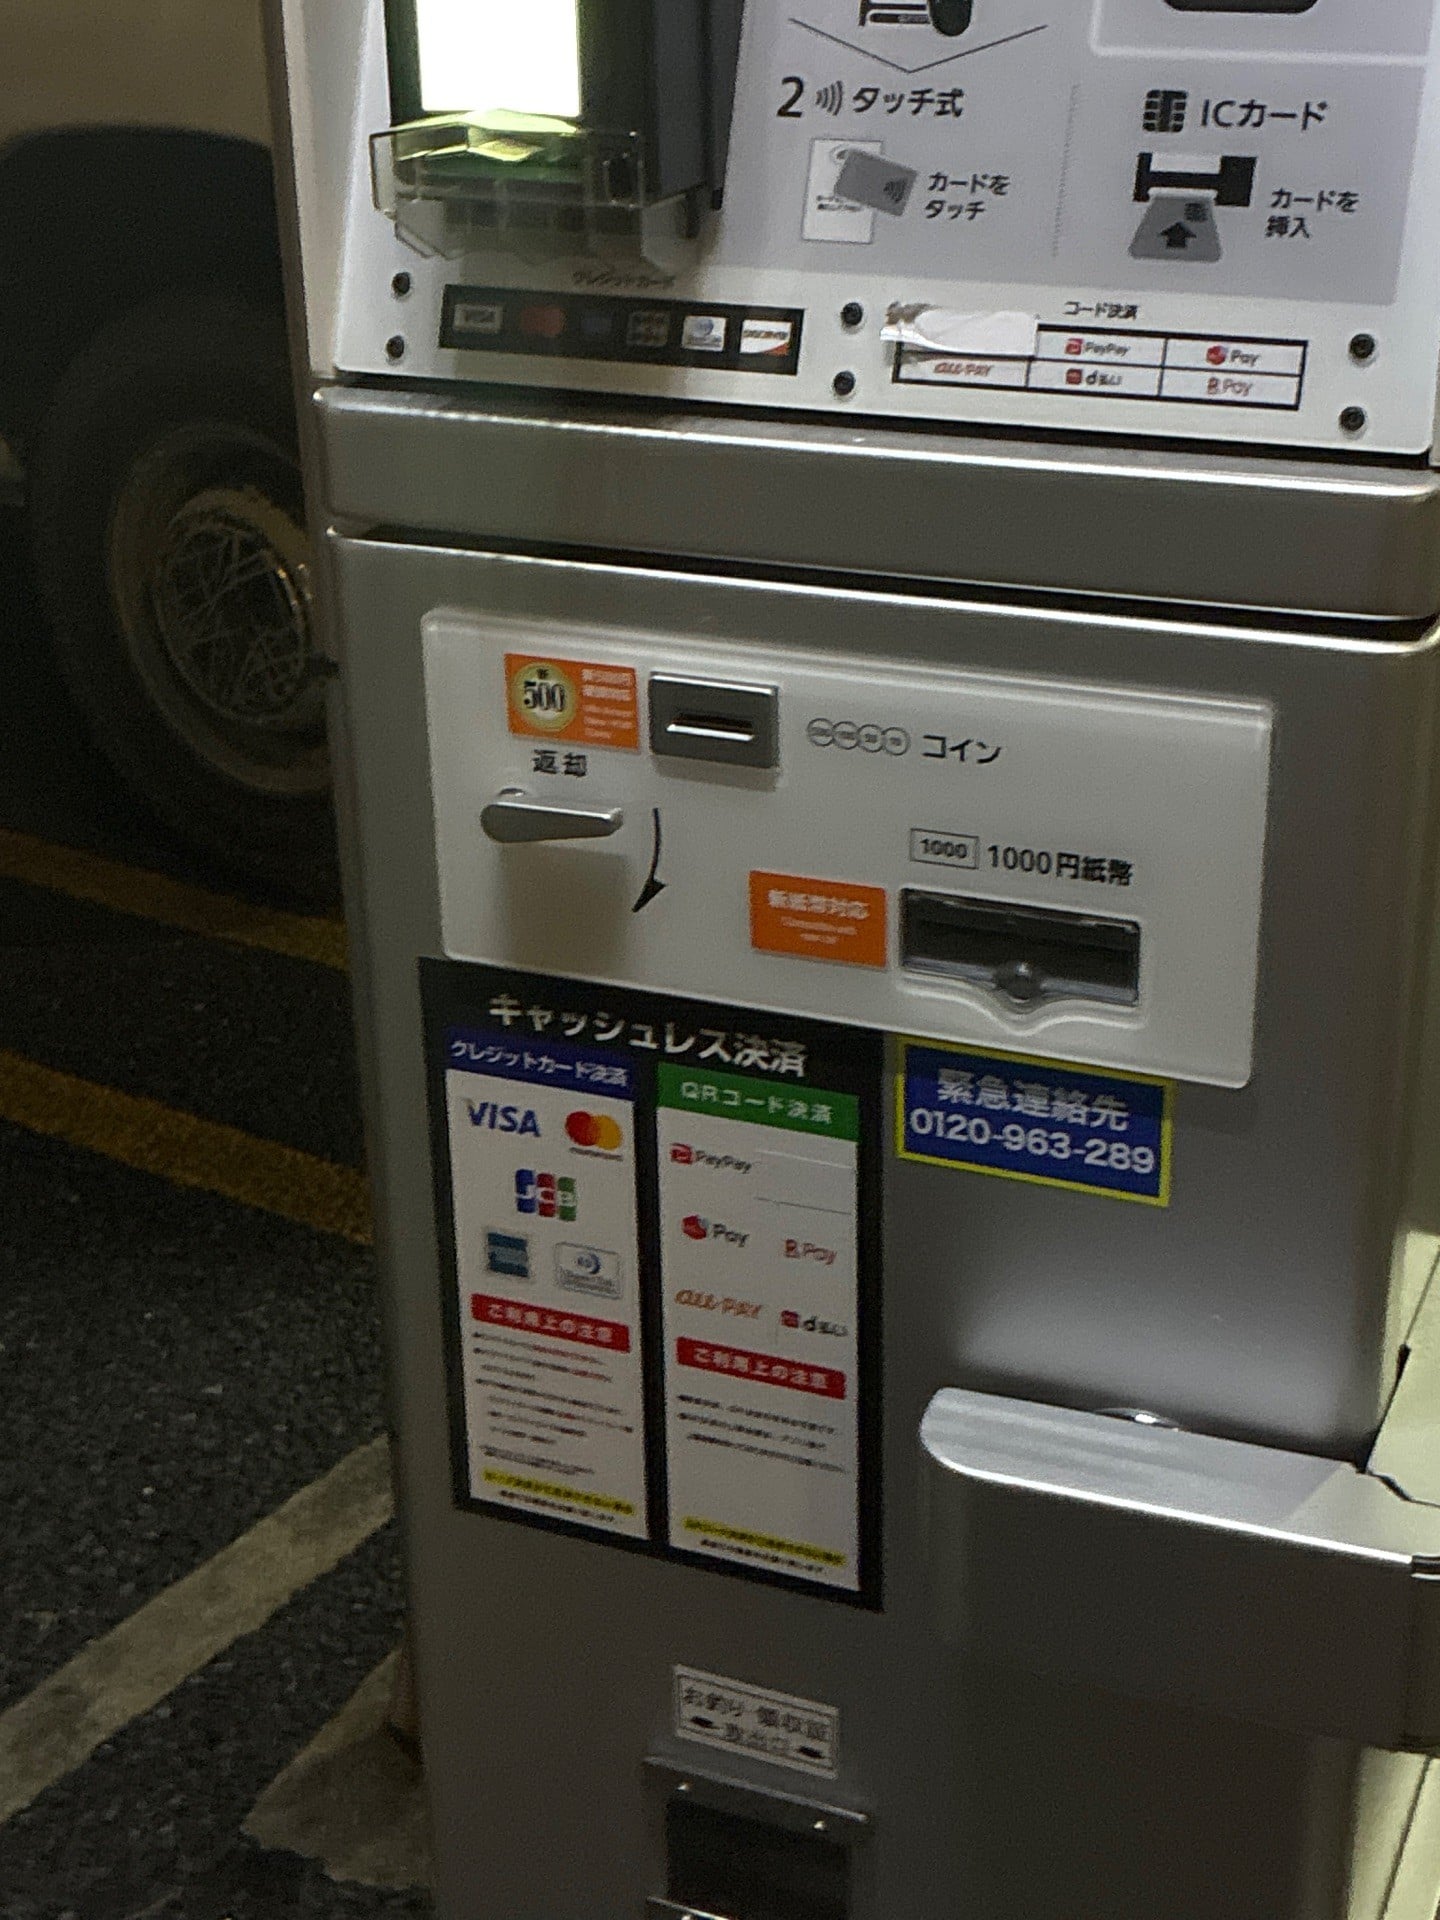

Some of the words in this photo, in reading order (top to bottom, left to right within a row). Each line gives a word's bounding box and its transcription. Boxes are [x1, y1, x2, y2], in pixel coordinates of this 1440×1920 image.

[776, 76, 805, 118] 2
[853, 87, 965, 117] タッチ式
[1200, 99, 1328, 130] ICカード
[928, 172, 1010, 195] カードを
[925, 200, 986, 220] タッチ
[1269, 188, 1359, 213] カードを
[1265, 215, 1312, 238] 挿入
[1085, 341, 1131, 357] PayPay
[1230, 348, 1260, 366] Pay
[523, 680, 567, 713] 500
[532, 749, 589, 777] 返却
[922, 734, 1001, 763] コイン
[920, 838, 968, 859] 1000
[987, 843, 1134, 887] 1000円紙幣
[488, 993, 809, 1078] キャッシュレス決済
[451, 1038, 631, 1088] クレジットカード決済
[680, 1081, 834, 1125] QRコード決済
[937, 1067, 1131, 1132] 緊急連絡先
[467, 1100, 541, 1138] VISA
[909, 1107, 1155, 1174] 0120-963-289
[695, 1149, 753, 1174] PayPay
[712, 1223, 750, 1247] Pay
